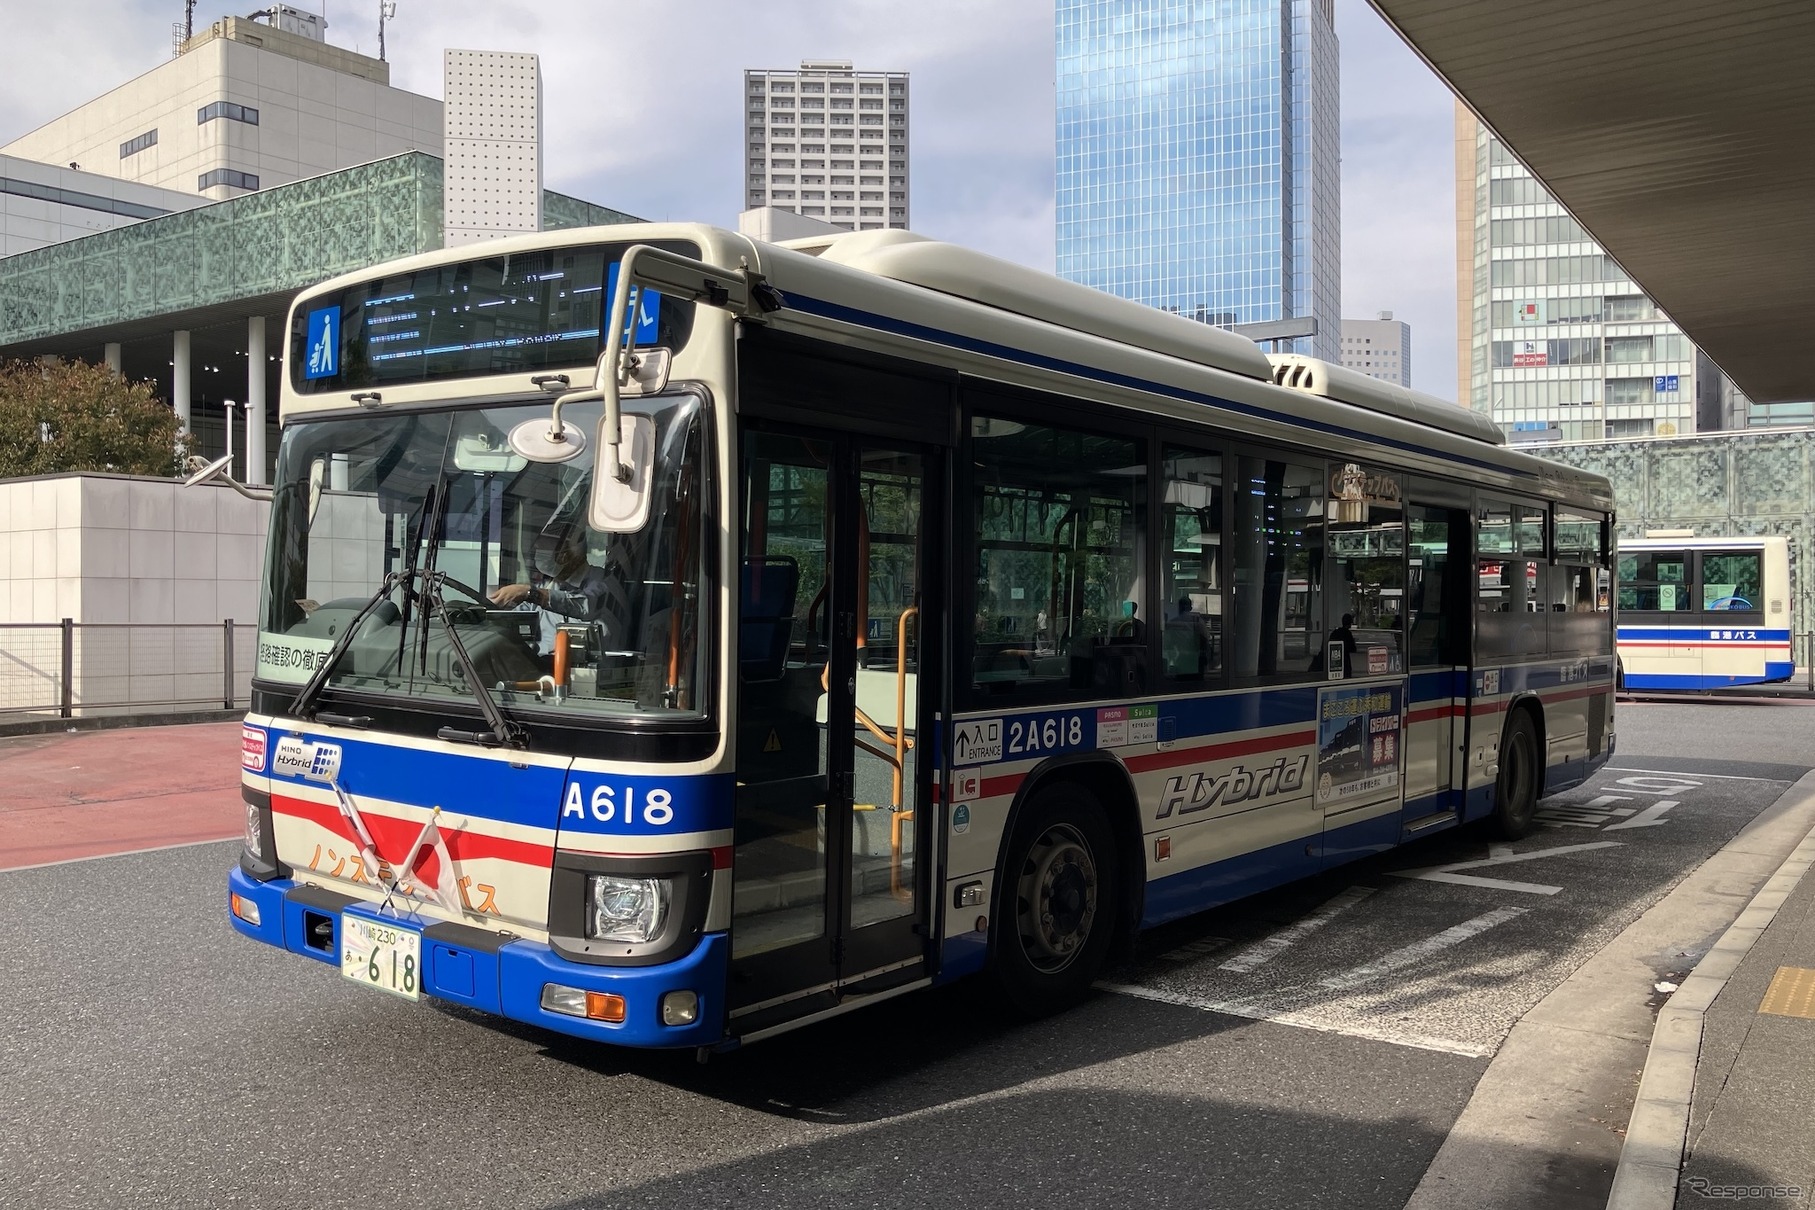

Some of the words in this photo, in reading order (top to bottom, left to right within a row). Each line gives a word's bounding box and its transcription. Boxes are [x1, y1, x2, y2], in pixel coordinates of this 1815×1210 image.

[1710, 631, 1757, 640] 臨港バス
[1104, 711, 1122, 720] PASMO
[1134, 708, 1152, 717] Suica
[974, 724, 998, 745] 入口
[1008, 716, 1082, 753] 2A618
[281, 745, 302, 755] HINO
[968, 745, 1002, 760] ENTRANCE
[1373, 735, 1394, 763] 募集
[277, 755, 313, 769] Hybrid
[1156, 754, 1311, 820] Hybrid
[563, 781, 675, 825] A618
